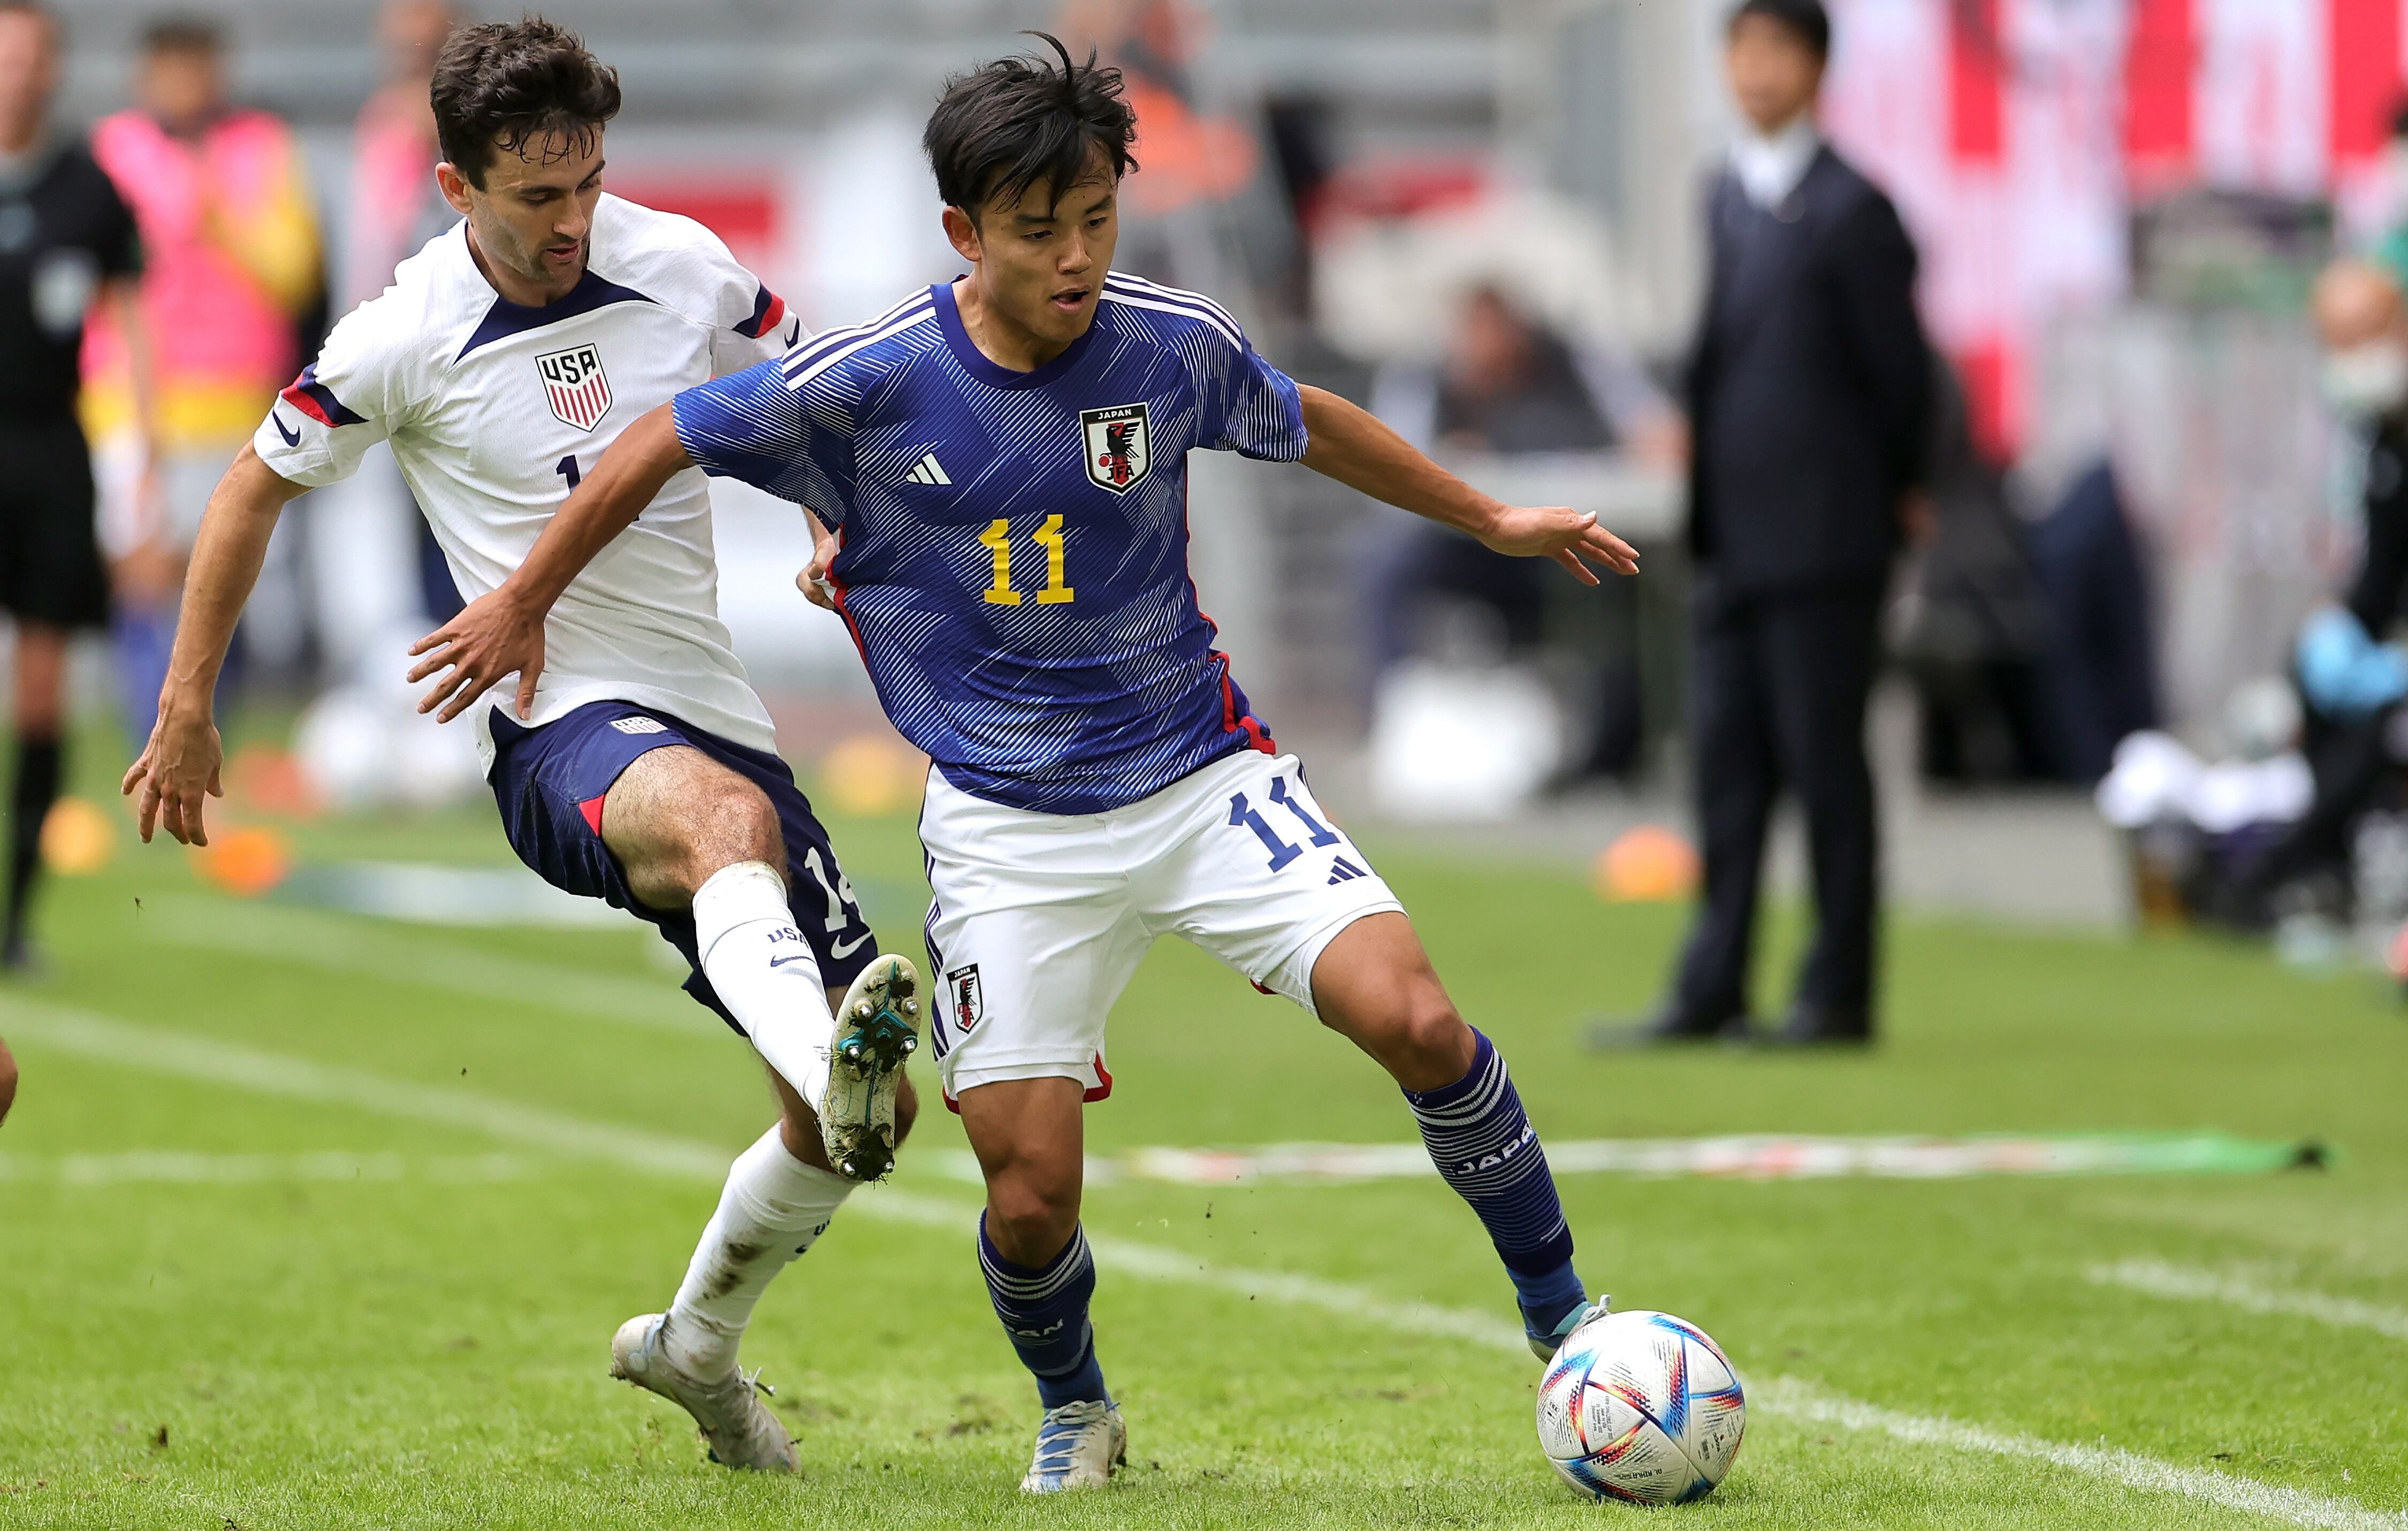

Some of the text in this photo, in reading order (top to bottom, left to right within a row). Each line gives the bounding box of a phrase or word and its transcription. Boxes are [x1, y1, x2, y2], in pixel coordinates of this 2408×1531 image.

[541, 350, 596, 384] USA
[1098, 409, 1132, 420] JAPAN
[1107, 464, 1134, 480] JFA
[978, 514, 1075, 605] 11
[1229, 776, 1342, 873] 11
[767, 927, 809, 949] USA
[954, 966, 971, 978] JAPAN
